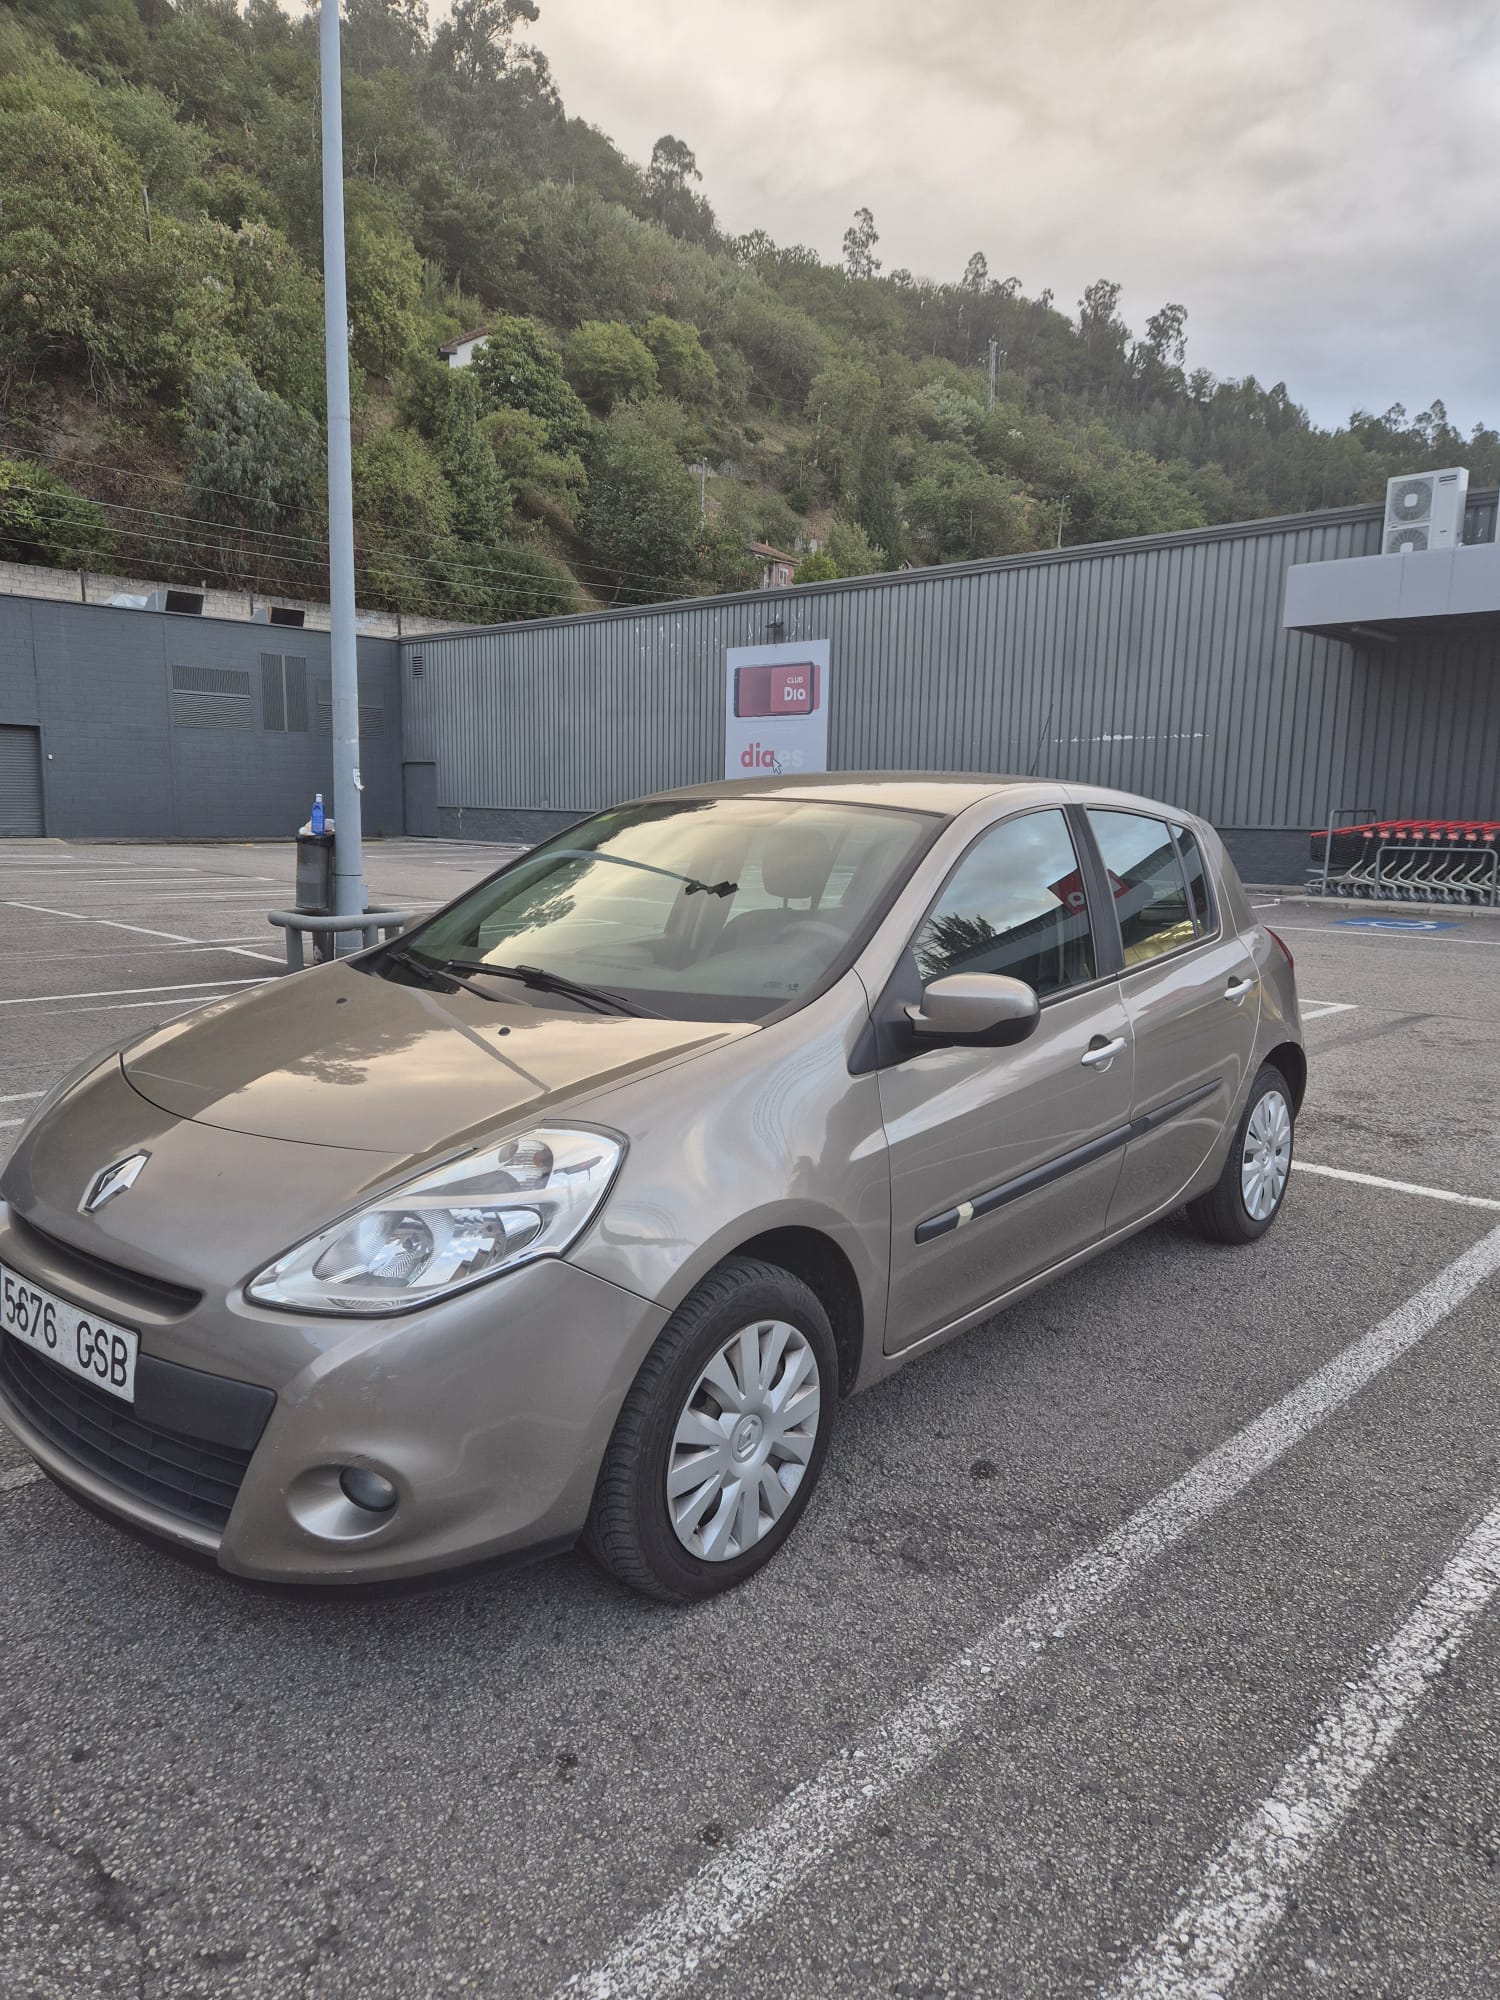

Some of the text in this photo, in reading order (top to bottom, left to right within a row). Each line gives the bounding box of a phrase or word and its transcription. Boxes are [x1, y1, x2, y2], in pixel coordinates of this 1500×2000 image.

[786, 676, 804, 684] CLUB
[4, 1276, 128, 1388] 5676 GSB
